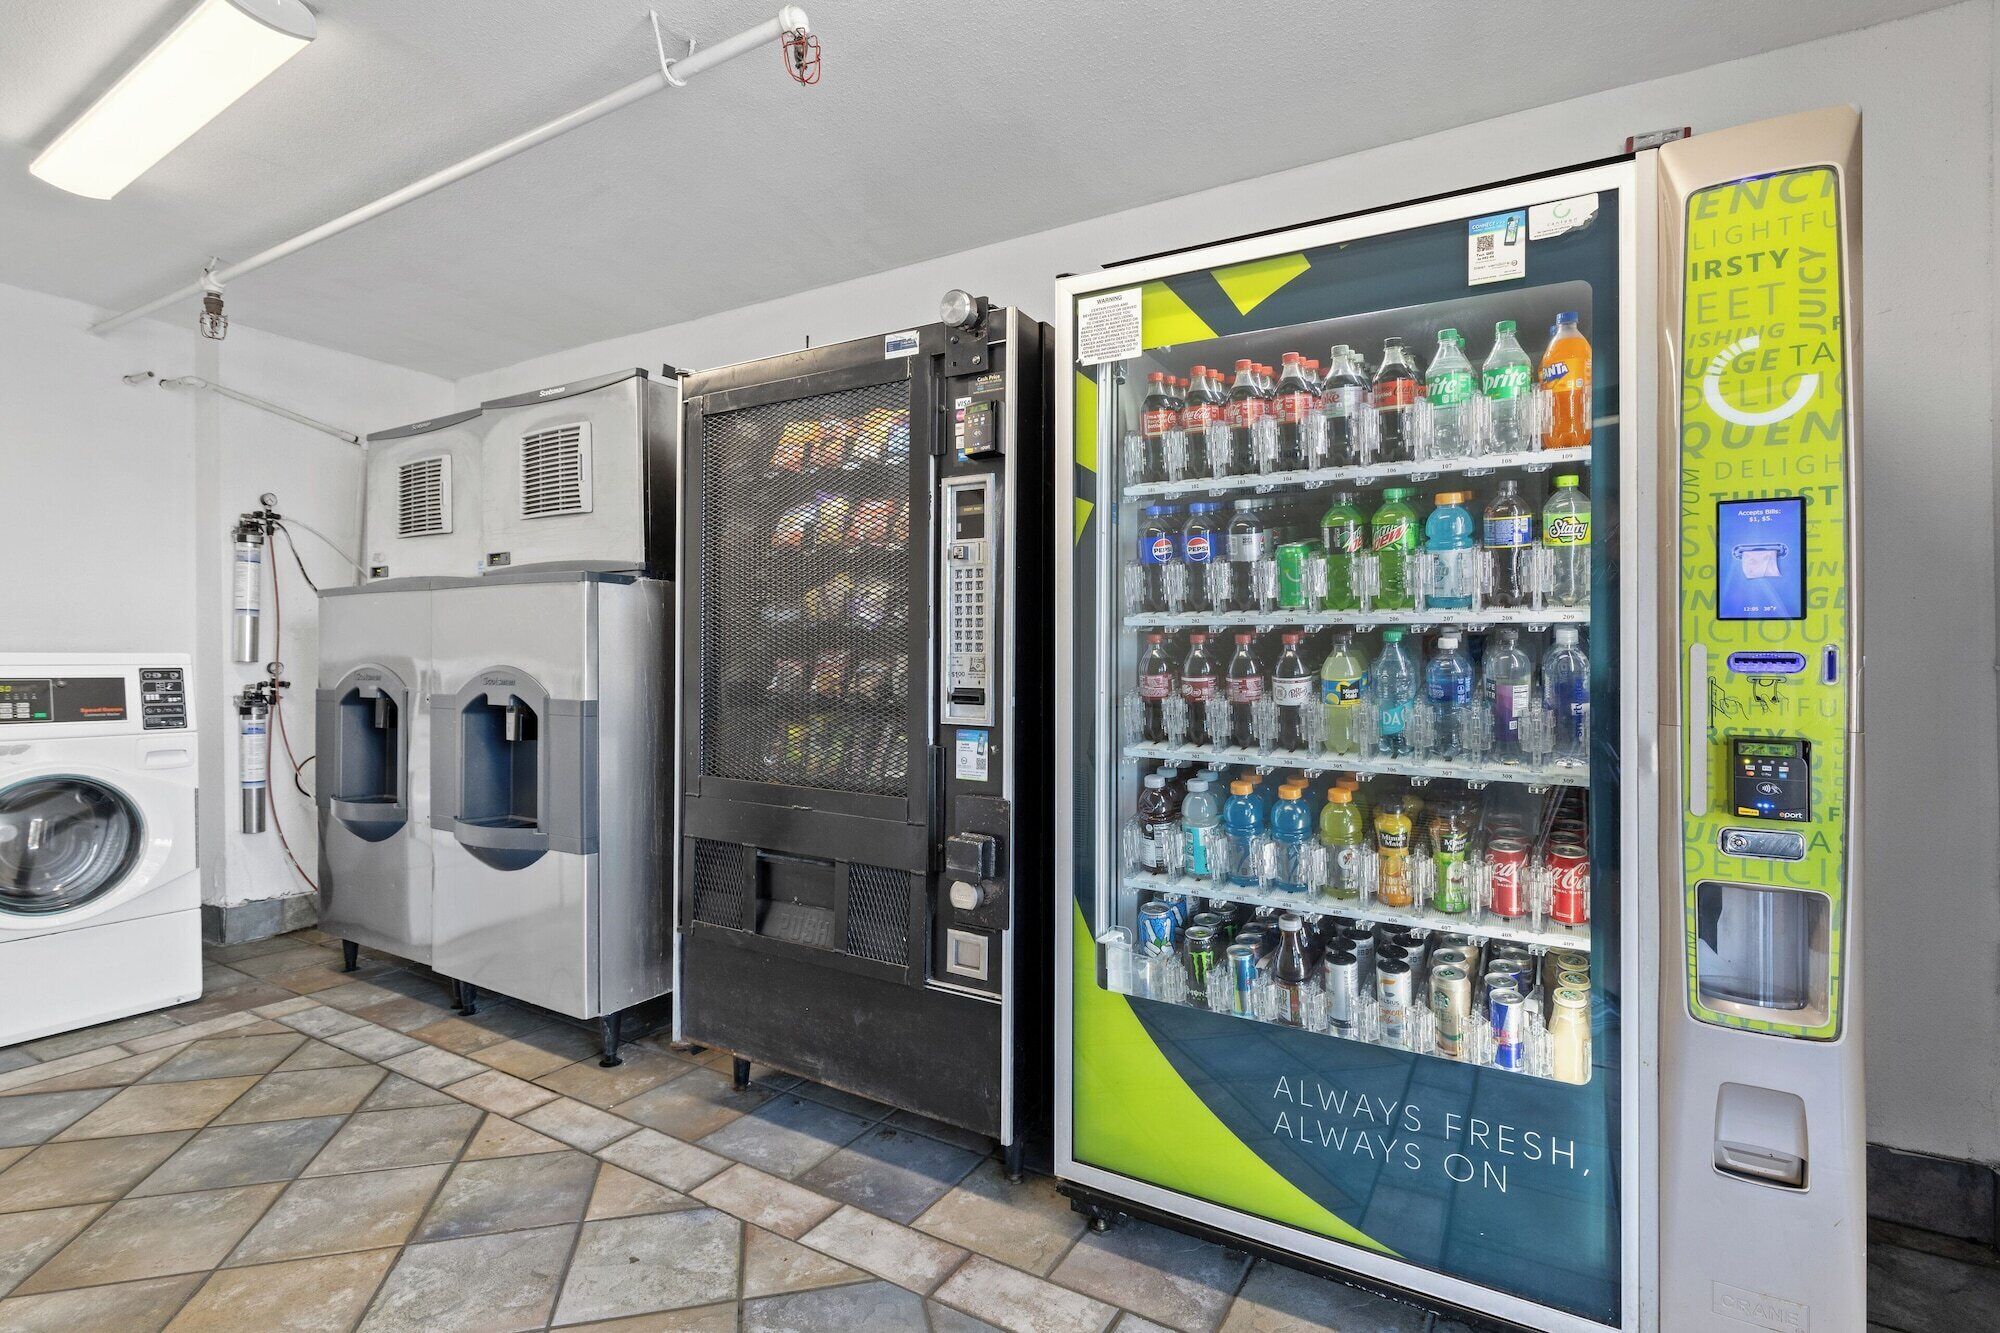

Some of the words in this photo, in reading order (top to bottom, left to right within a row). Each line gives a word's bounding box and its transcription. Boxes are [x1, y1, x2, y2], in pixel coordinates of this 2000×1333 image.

[1798, 246, 1827, 336] JUICY
[1482, 368, 1526, 395] Sprite
[1542, 362, 1568, 381] ANTA
[538, 386, 566, 398] Scotsman
[1426, 377, 1457, 397] rite
[1550, 520, 1588, 540] Starry
[1154, 545, 1173, 554] PEPSI
[1273, 1076, 1421, 1132] ALWAYS
[1446, 1112, 1590, 1178] FRESH,
[1273, 1112, 1421, 1170] ALWAYS
[1444, 1154, 1506, 1193] ON
[1721, 1294, 1799, 1326] CRANE
